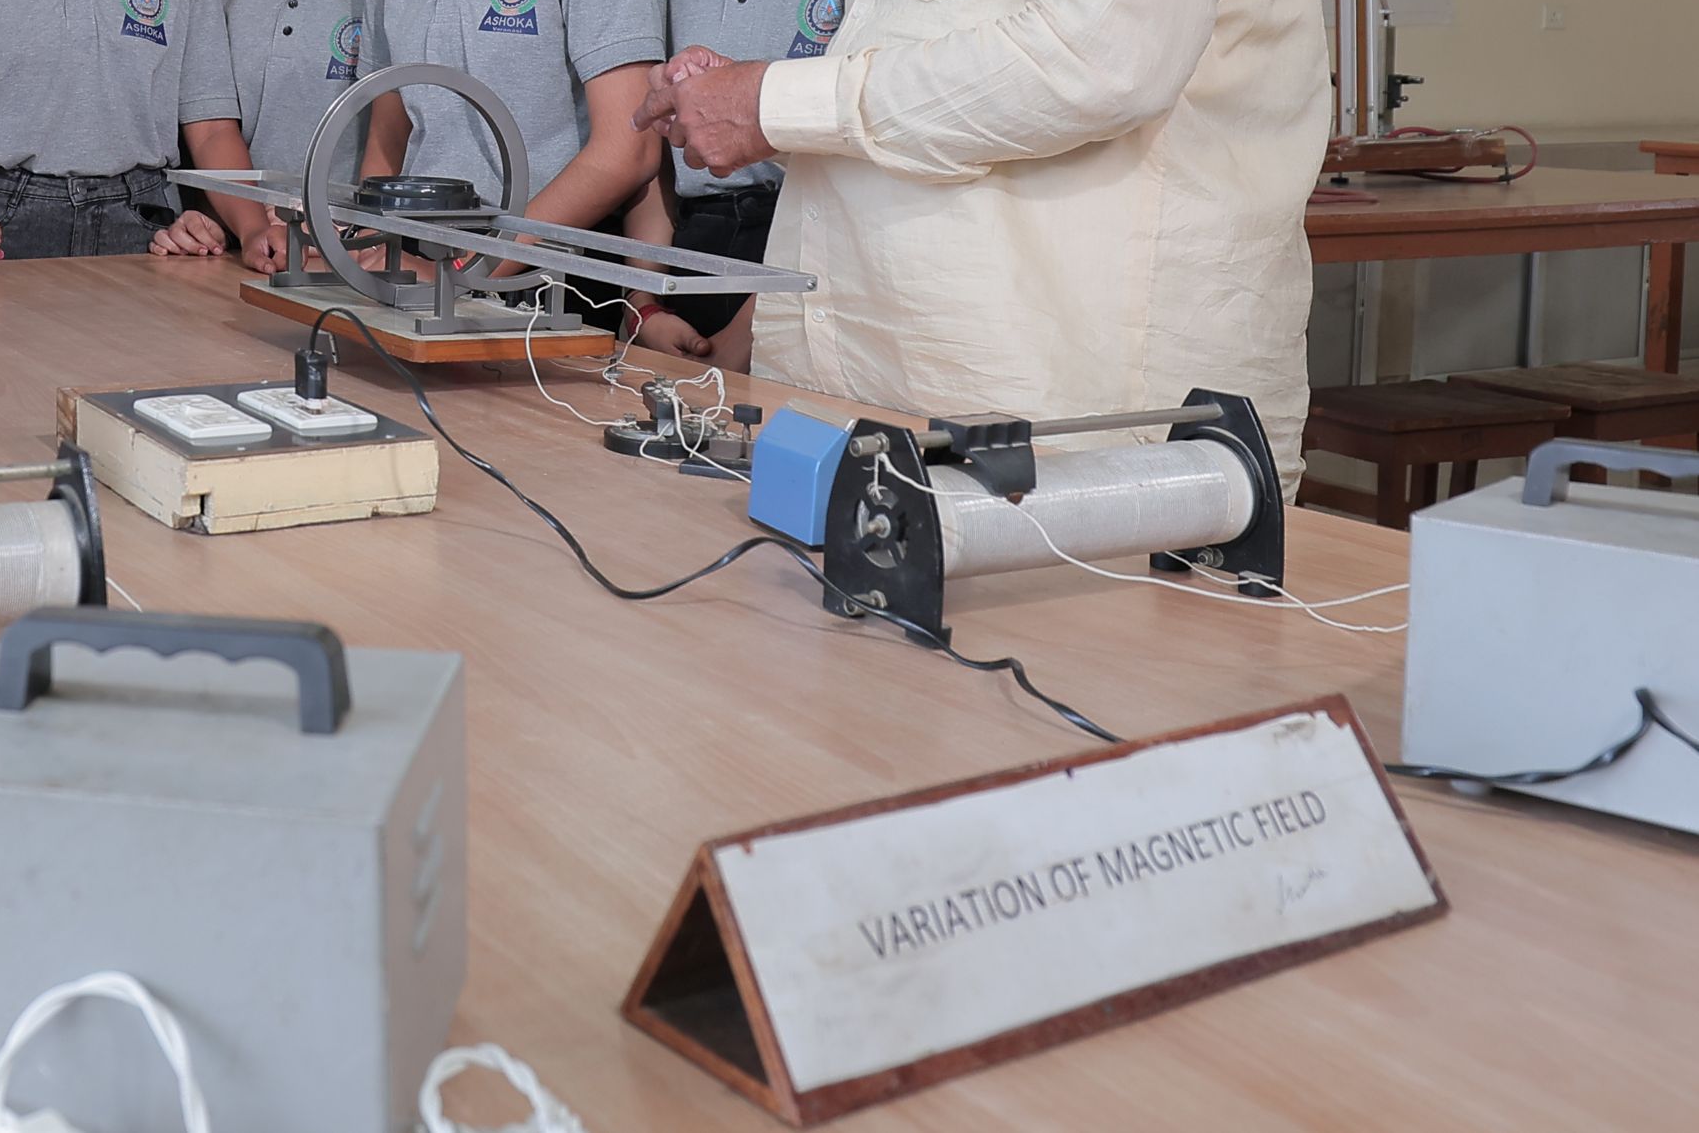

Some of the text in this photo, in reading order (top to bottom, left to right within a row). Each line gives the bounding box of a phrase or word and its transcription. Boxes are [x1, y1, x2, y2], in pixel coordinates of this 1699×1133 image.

[483, 15, 534, 29] ASHOKA
[125, 22, 164, 41] ASHOKA
[792, 43, 824, 55] ASH
[330, 65, 358, 75] ASH
[858, 789, 1327, 959] VARIATION OF MAGNETIC FIELD
